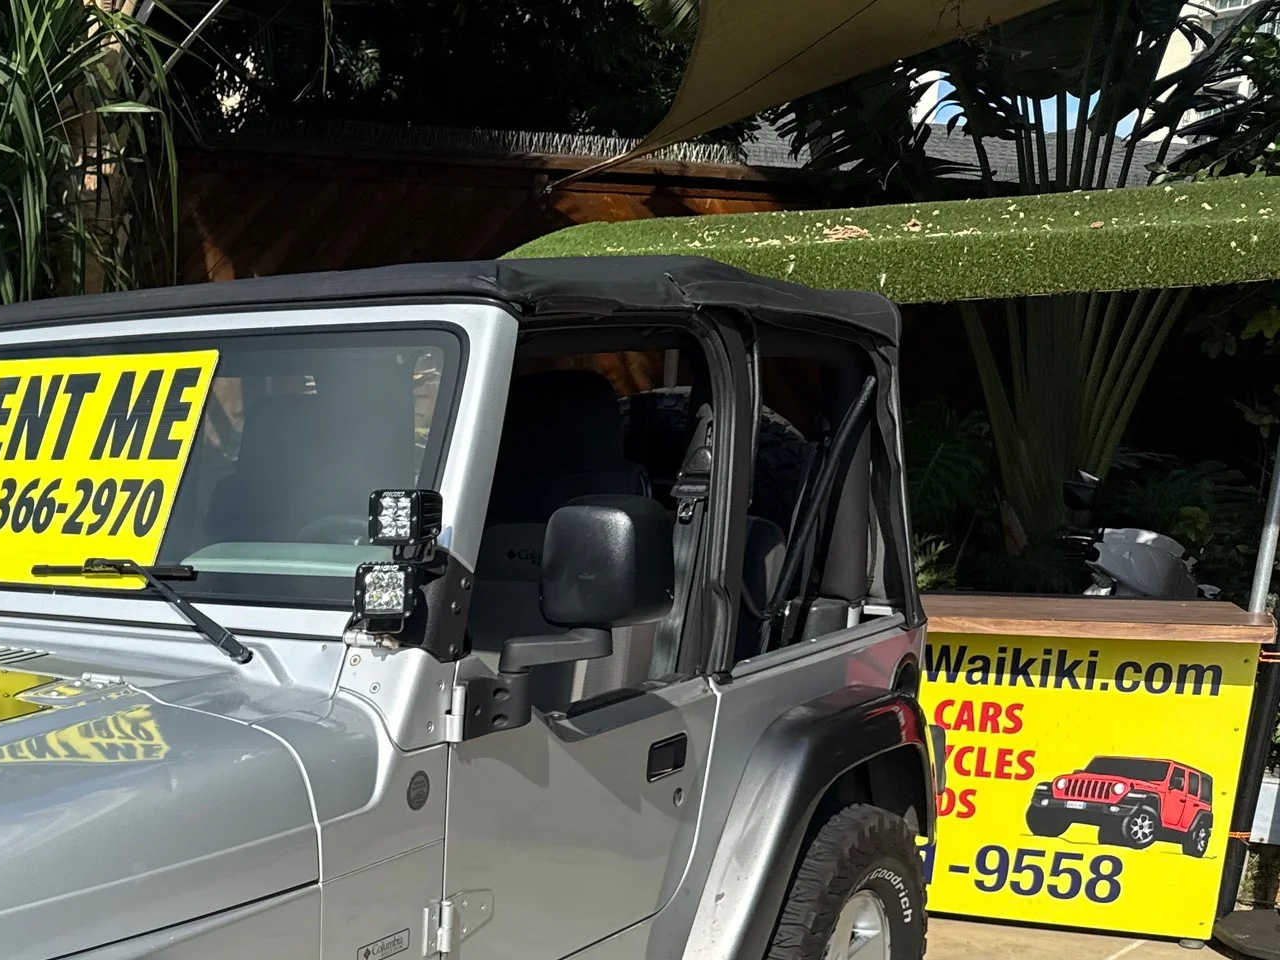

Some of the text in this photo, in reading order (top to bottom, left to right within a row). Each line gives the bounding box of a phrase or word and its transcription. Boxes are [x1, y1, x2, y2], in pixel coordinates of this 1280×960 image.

[90, 366, 203, 461] ME
[372, 564, 400, 572] RIGID
[924, 643, 1223, 697] Waikiki.com
[933, 699, 1025, 735] CARS
[371, 936, 404, 956] Columbia
